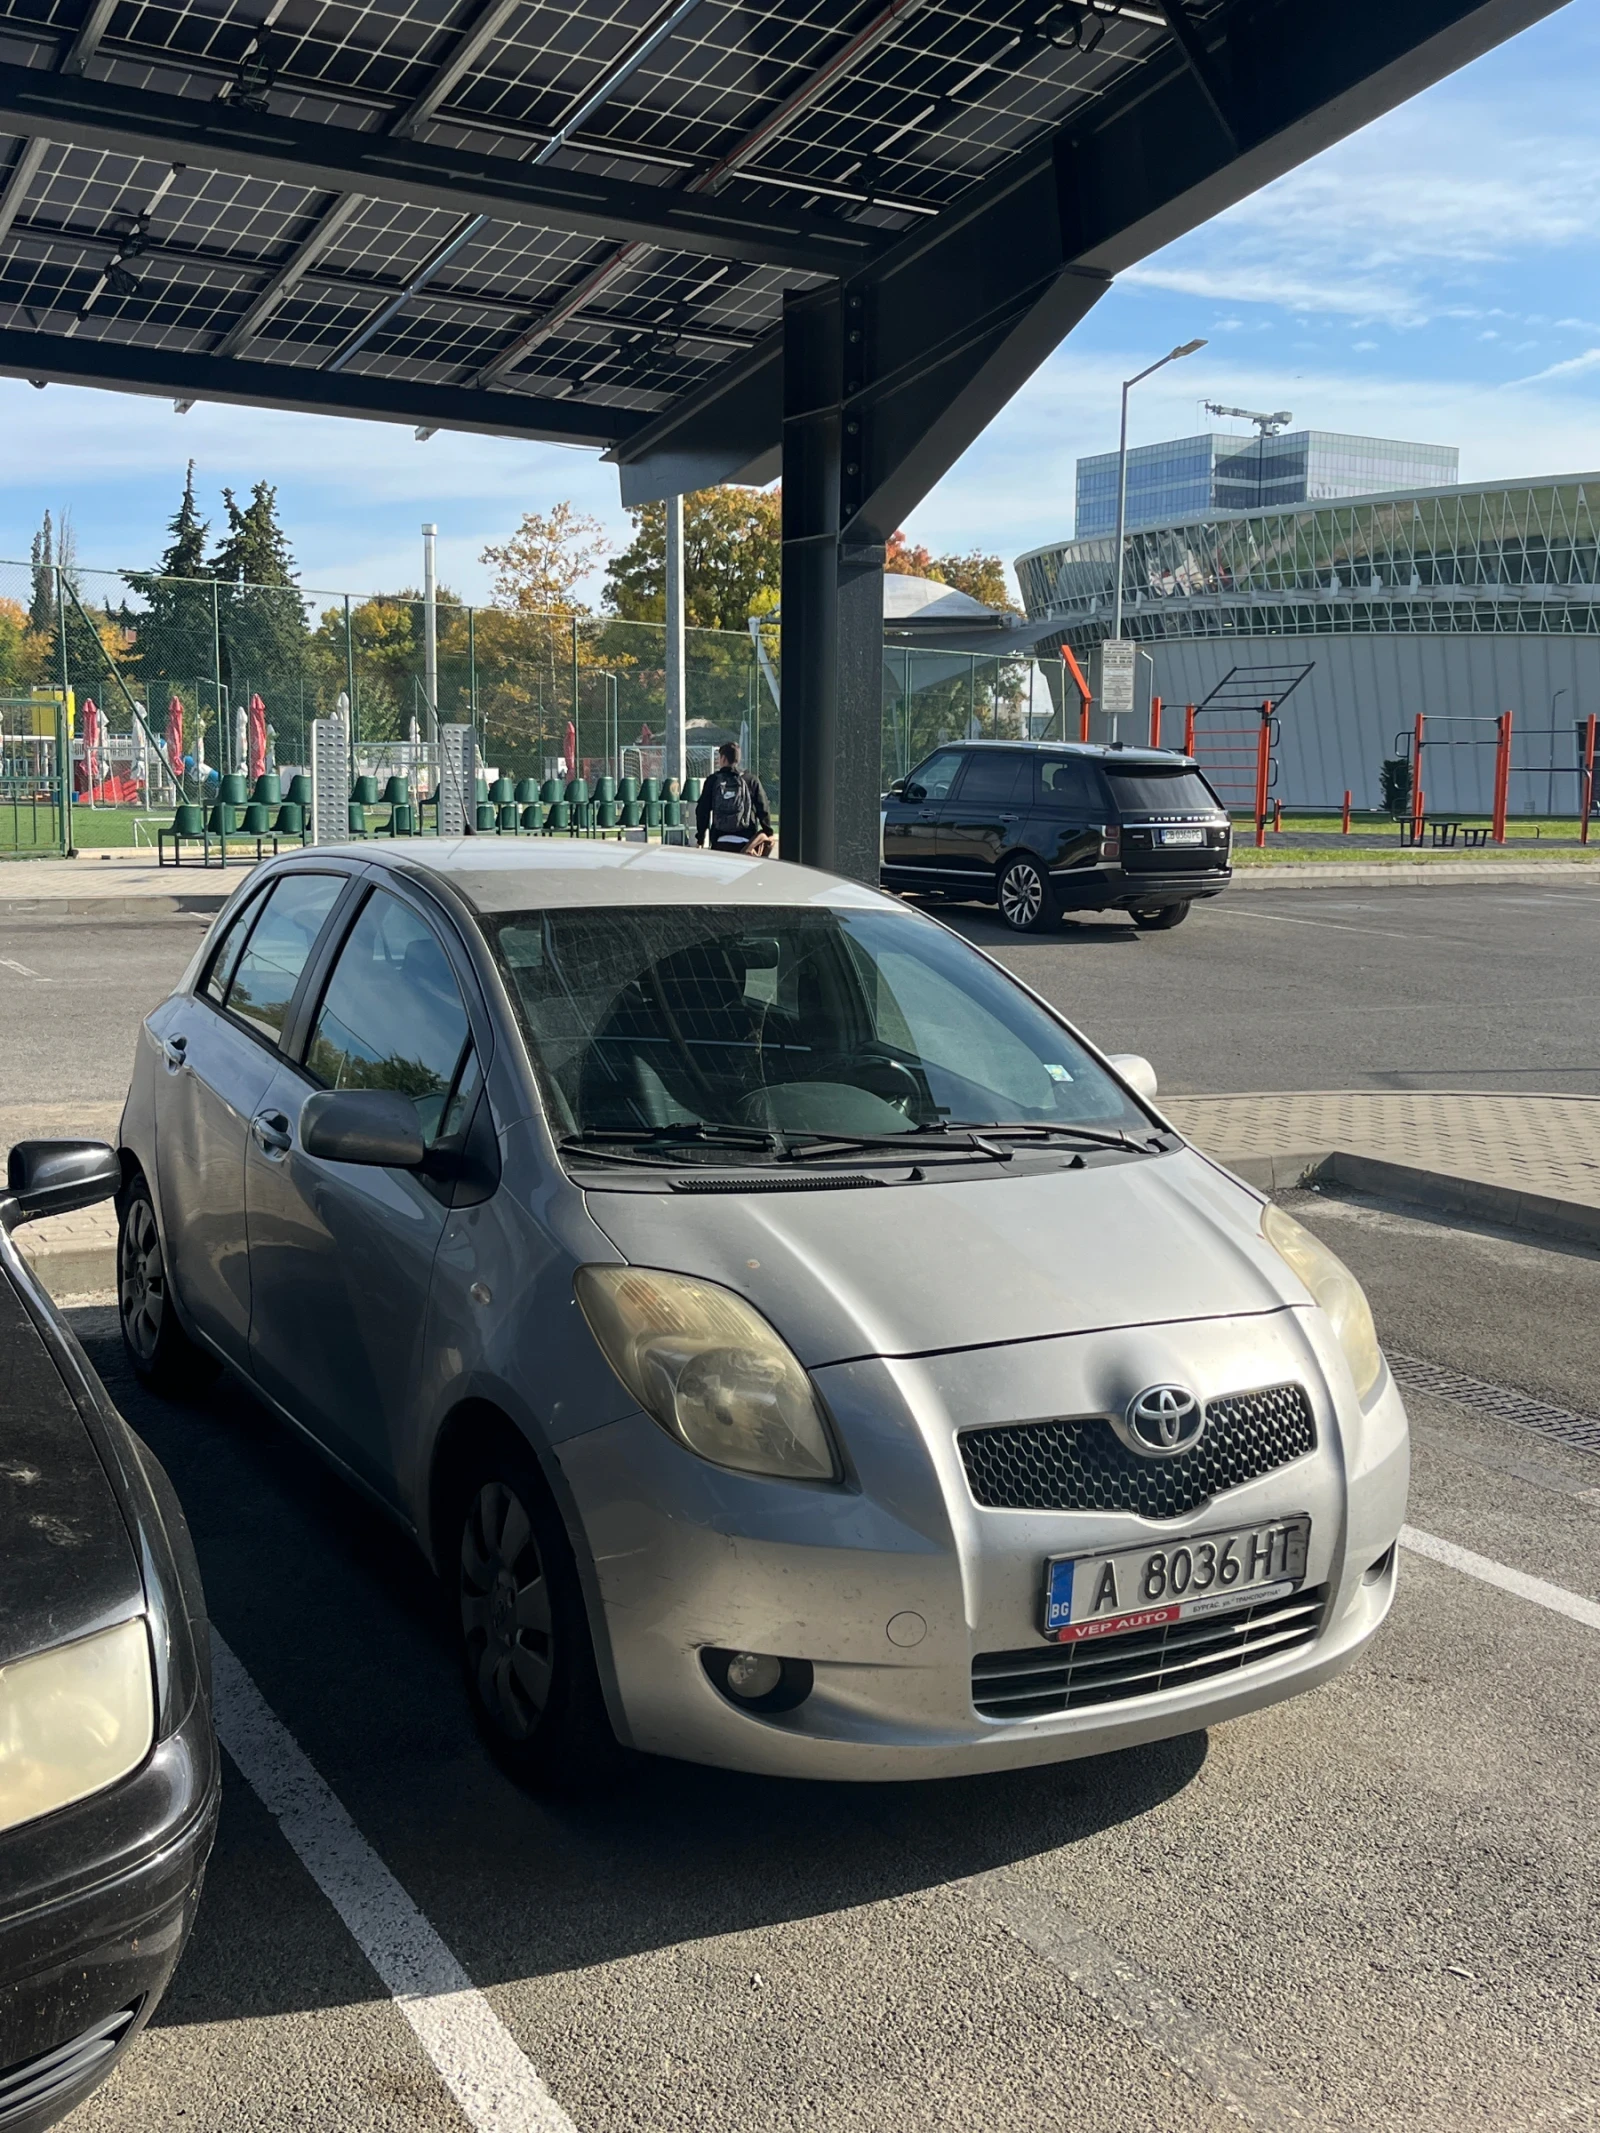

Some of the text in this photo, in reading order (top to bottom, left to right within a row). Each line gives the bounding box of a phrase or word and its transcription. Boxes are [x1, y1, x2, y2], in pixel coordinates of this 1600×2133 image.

[1095, 1525, 1299, 1612] A 8036 HT
[1051, 1602, 1069, 1618] BG
[1075, 1612, 1168, 1637] VEP AUTO
